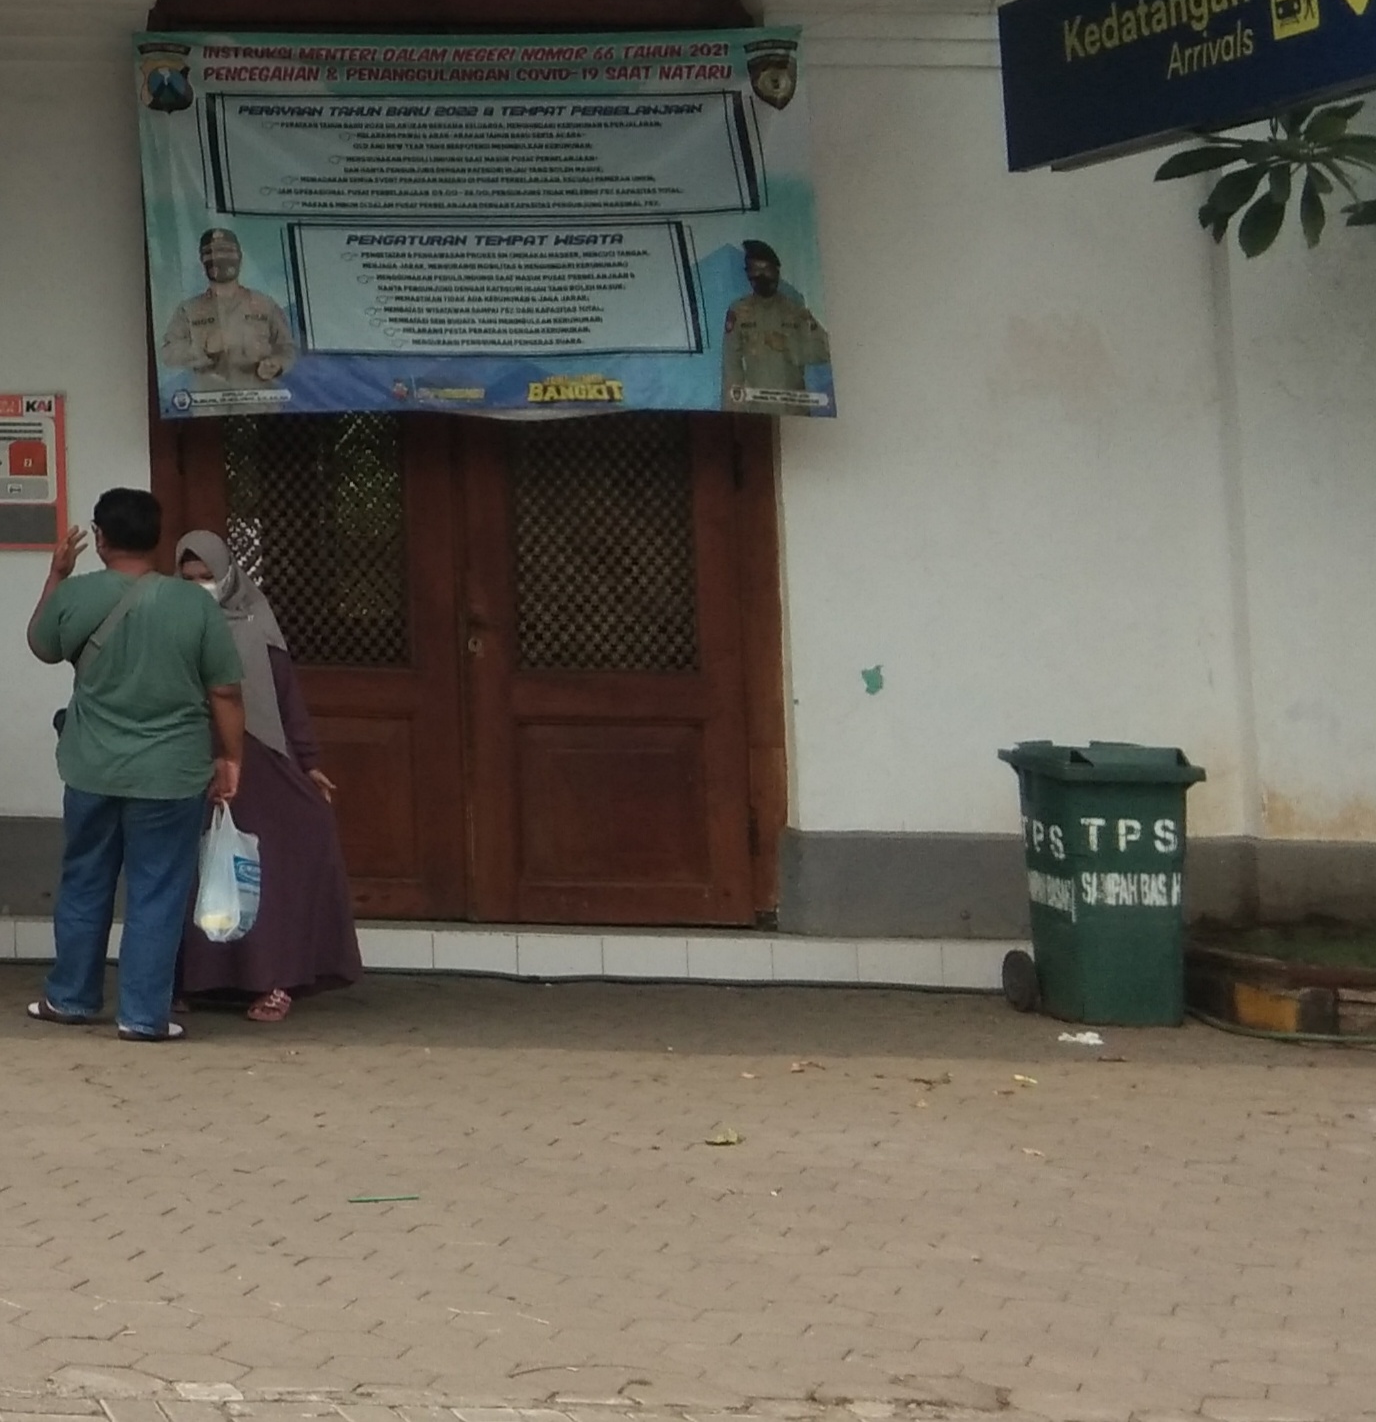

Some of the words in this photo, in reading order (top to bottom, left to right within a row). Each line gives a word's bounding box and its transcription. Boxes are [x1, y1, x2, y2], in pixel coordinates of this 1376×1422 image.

[298, 47, 377, 62] MENTERI
[382, 48, 448, 62] DALAM
[451, 47, 515, 61] NEGERI
[520, 47, 587, 61] NOMOR
[593, 47, 614, 60] 66
[623, 46, 681, 59] TAHUN
[689, 43, 729, 57] 2021
[1167, 21, 1255, 80] Arrivals
[203, 66, 320, 82] PENCEGAHAN
[346, 68, 510, 82] PENANGGULANGAN
[605, 66, 650, 80] SAAT
[658, 64, 732, 80] NATARU
[330, 105, 382, 116] TAHUN
[386, 106, 430, 117] BARU
[502, 105, 567, 117] TEMPAT
[570, 103, 703, 117] PERBELANJAAN
[346, 234, 468, 247] PENGATURAN
[475, 234, 549, 247] TEMPAT
[554, 233, 624, 246] WISATA
[527, 380, 624, 403] BANGKIT
[25, 400, 53, 413] KAI
[1080, 817, 1179, 853] TPS
